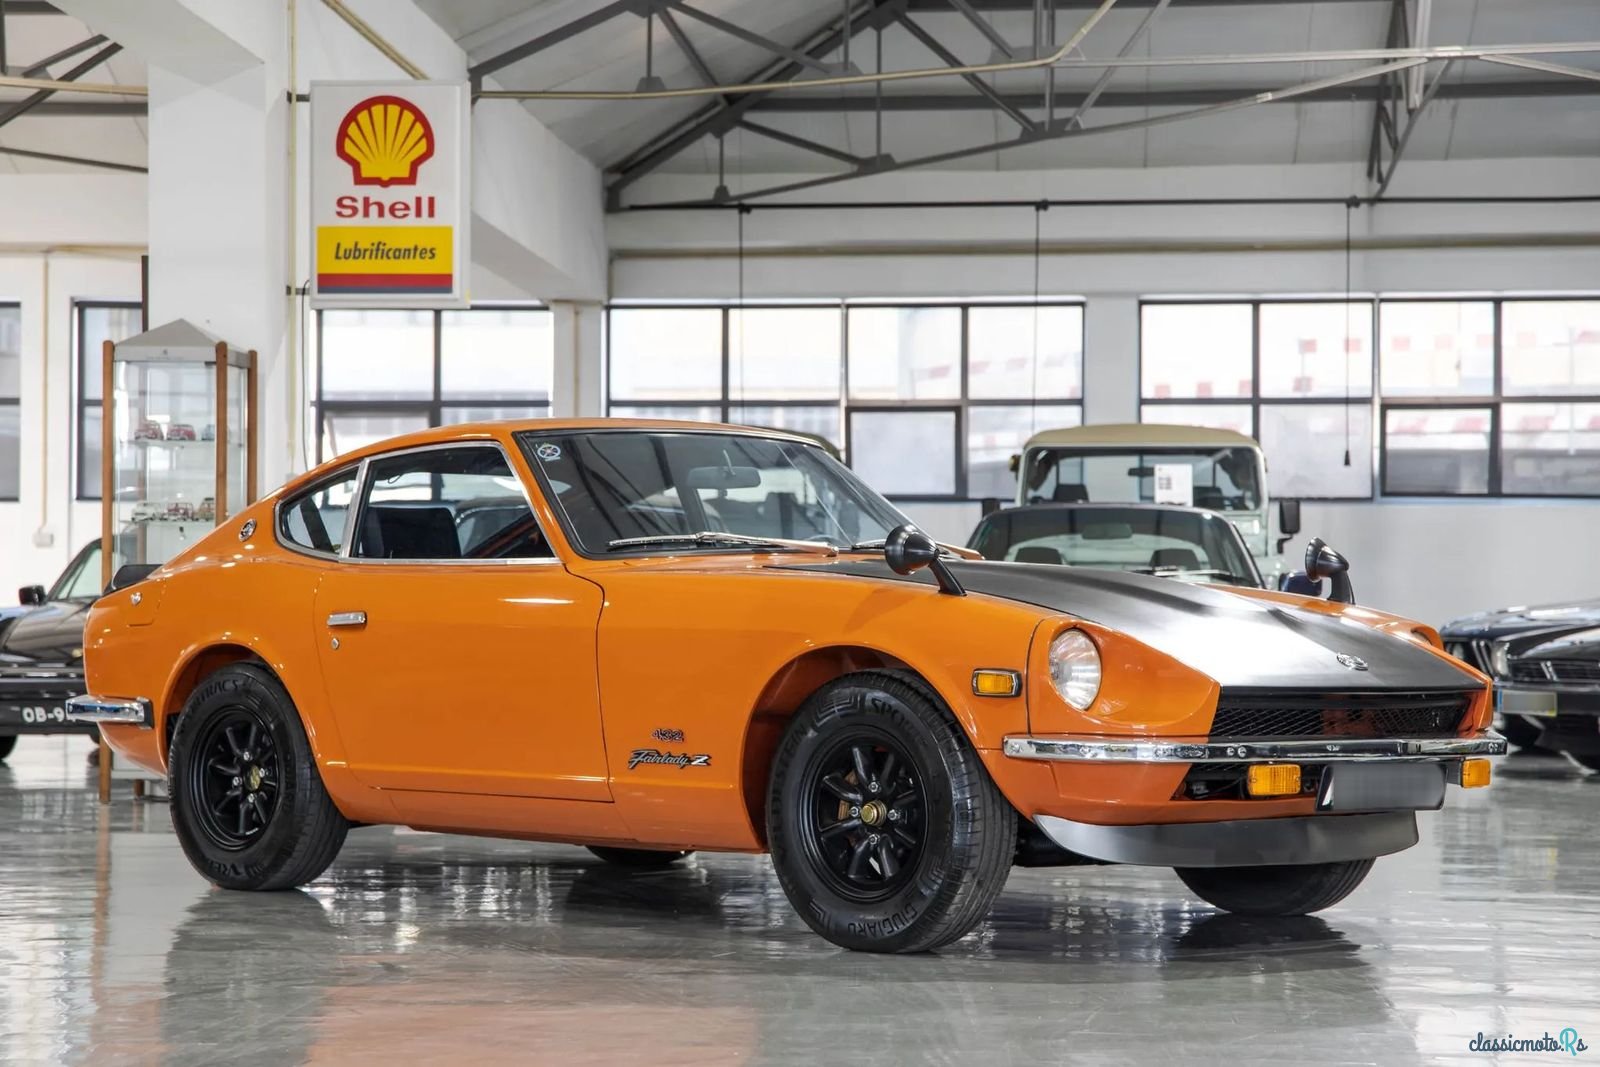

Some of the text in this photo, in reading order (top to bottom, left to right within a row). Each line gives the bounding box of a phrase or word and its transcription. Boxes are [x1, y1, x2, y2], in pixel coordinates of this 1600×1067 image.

[336, 195, 435, 218] Shell
[335, 241, 436, 260] Lubrificantes
[22, 707, 65, 723] OB-9
[628, 748, 690, 769] Fairlady
